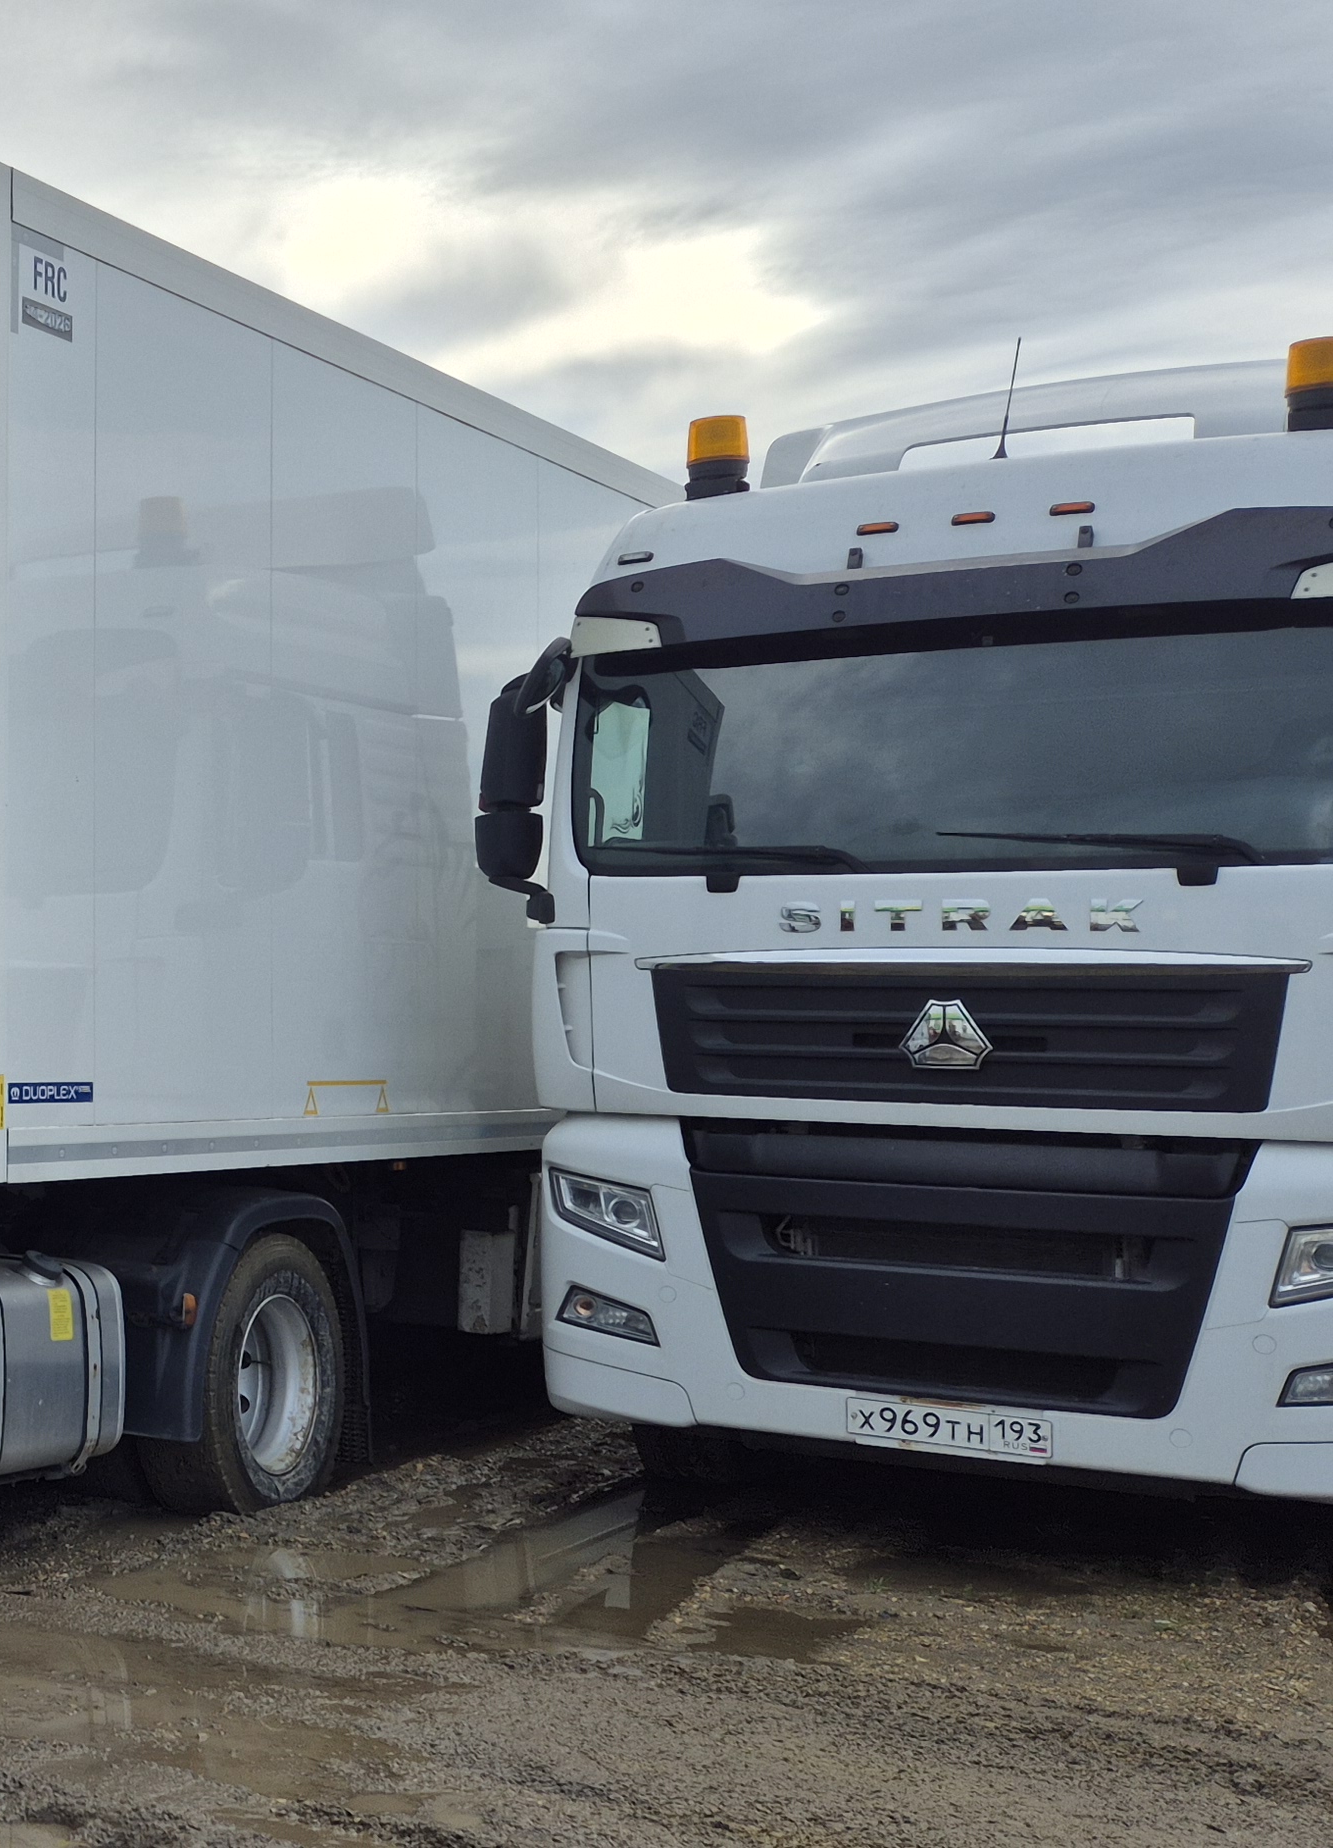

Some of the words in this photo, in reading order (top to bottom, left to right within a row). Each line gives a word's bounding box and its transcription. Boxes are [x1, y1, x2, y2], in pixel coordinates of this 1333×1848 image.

[33, 255, 67, 303] FRC
[779, 899, 1144, 933] SITRAK
[22, 1085, 77, 1100] DUOPLEX
[994, 1419, 1042, 1443] 193
[1003, 1440, 1028, 1450] RUS
